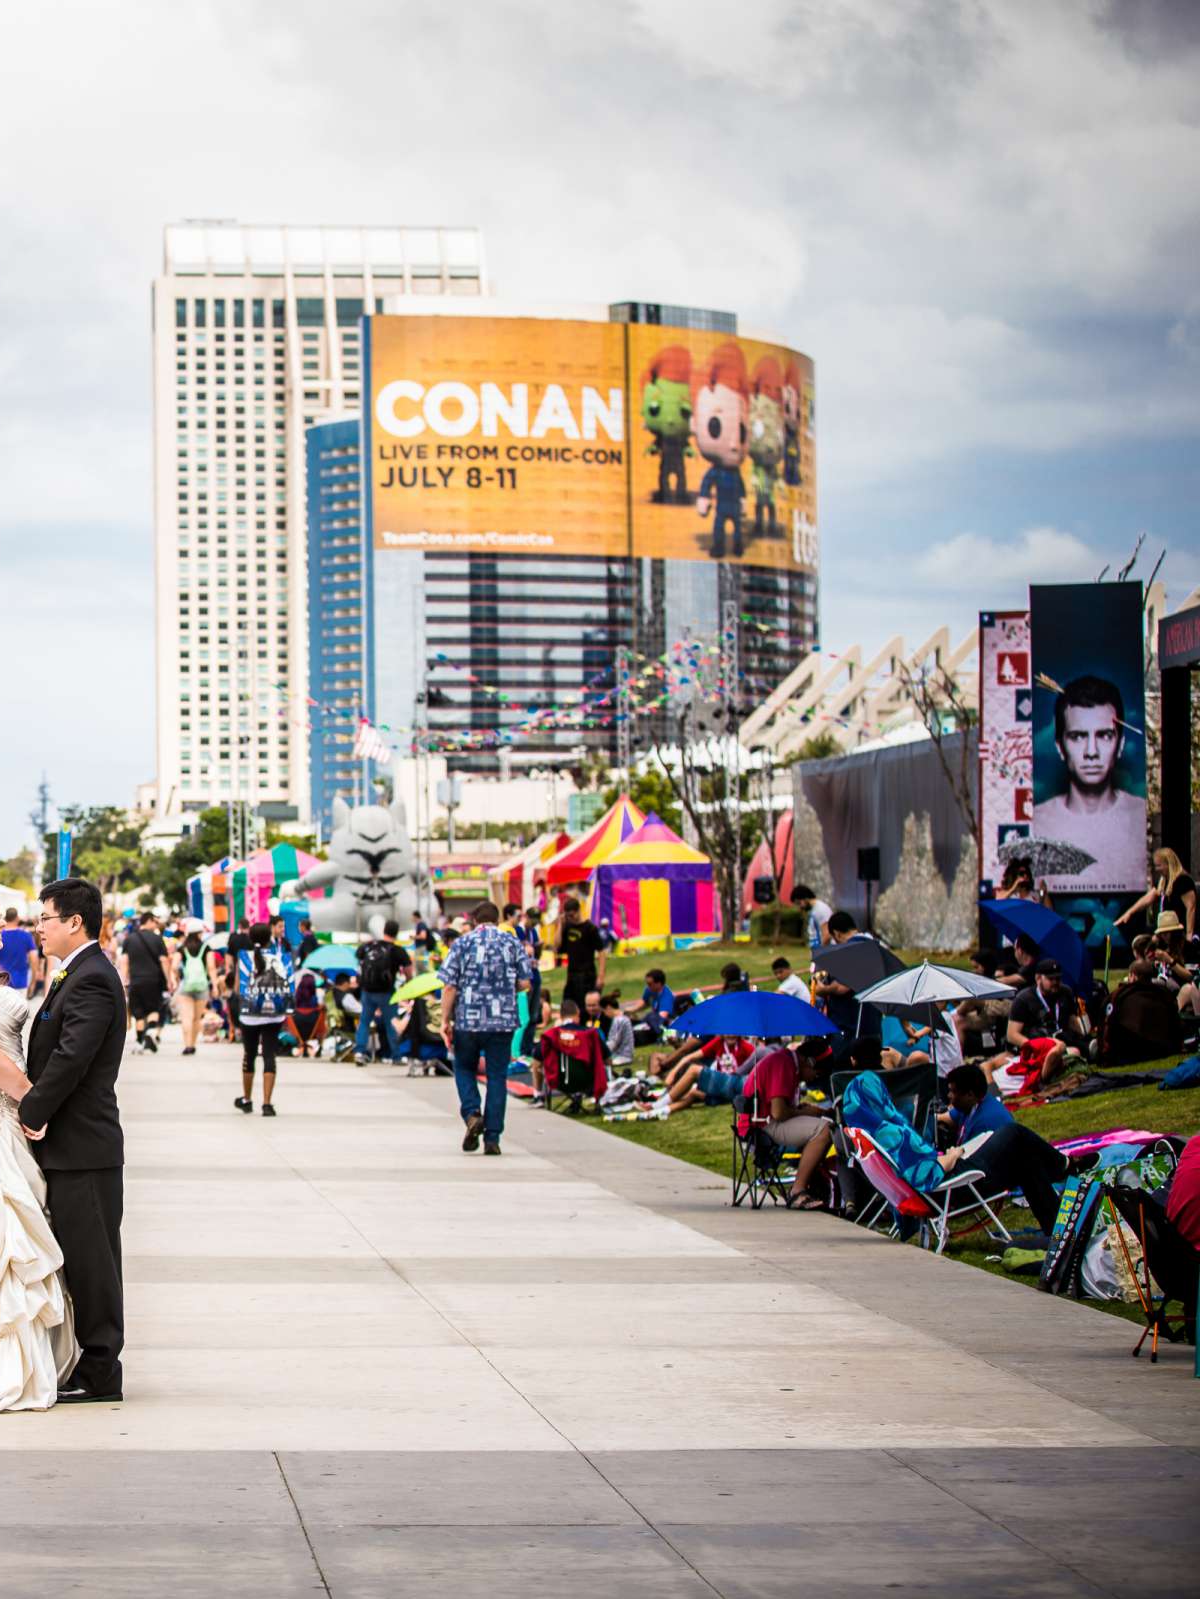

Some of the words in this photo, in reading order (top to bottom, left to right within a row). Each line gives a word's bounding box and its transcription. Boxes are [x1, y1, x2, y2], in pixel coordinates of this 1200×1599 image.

[376, 380, 624, 442] CONAN
[380, 445, 429, 460] LIVE
[437, 445, 499, 461] FROM
[506, 446, 623, 465] COMIC-CON
[380, 467, 454, 488] JULY
[466, 467, 517, 489] 8-11
